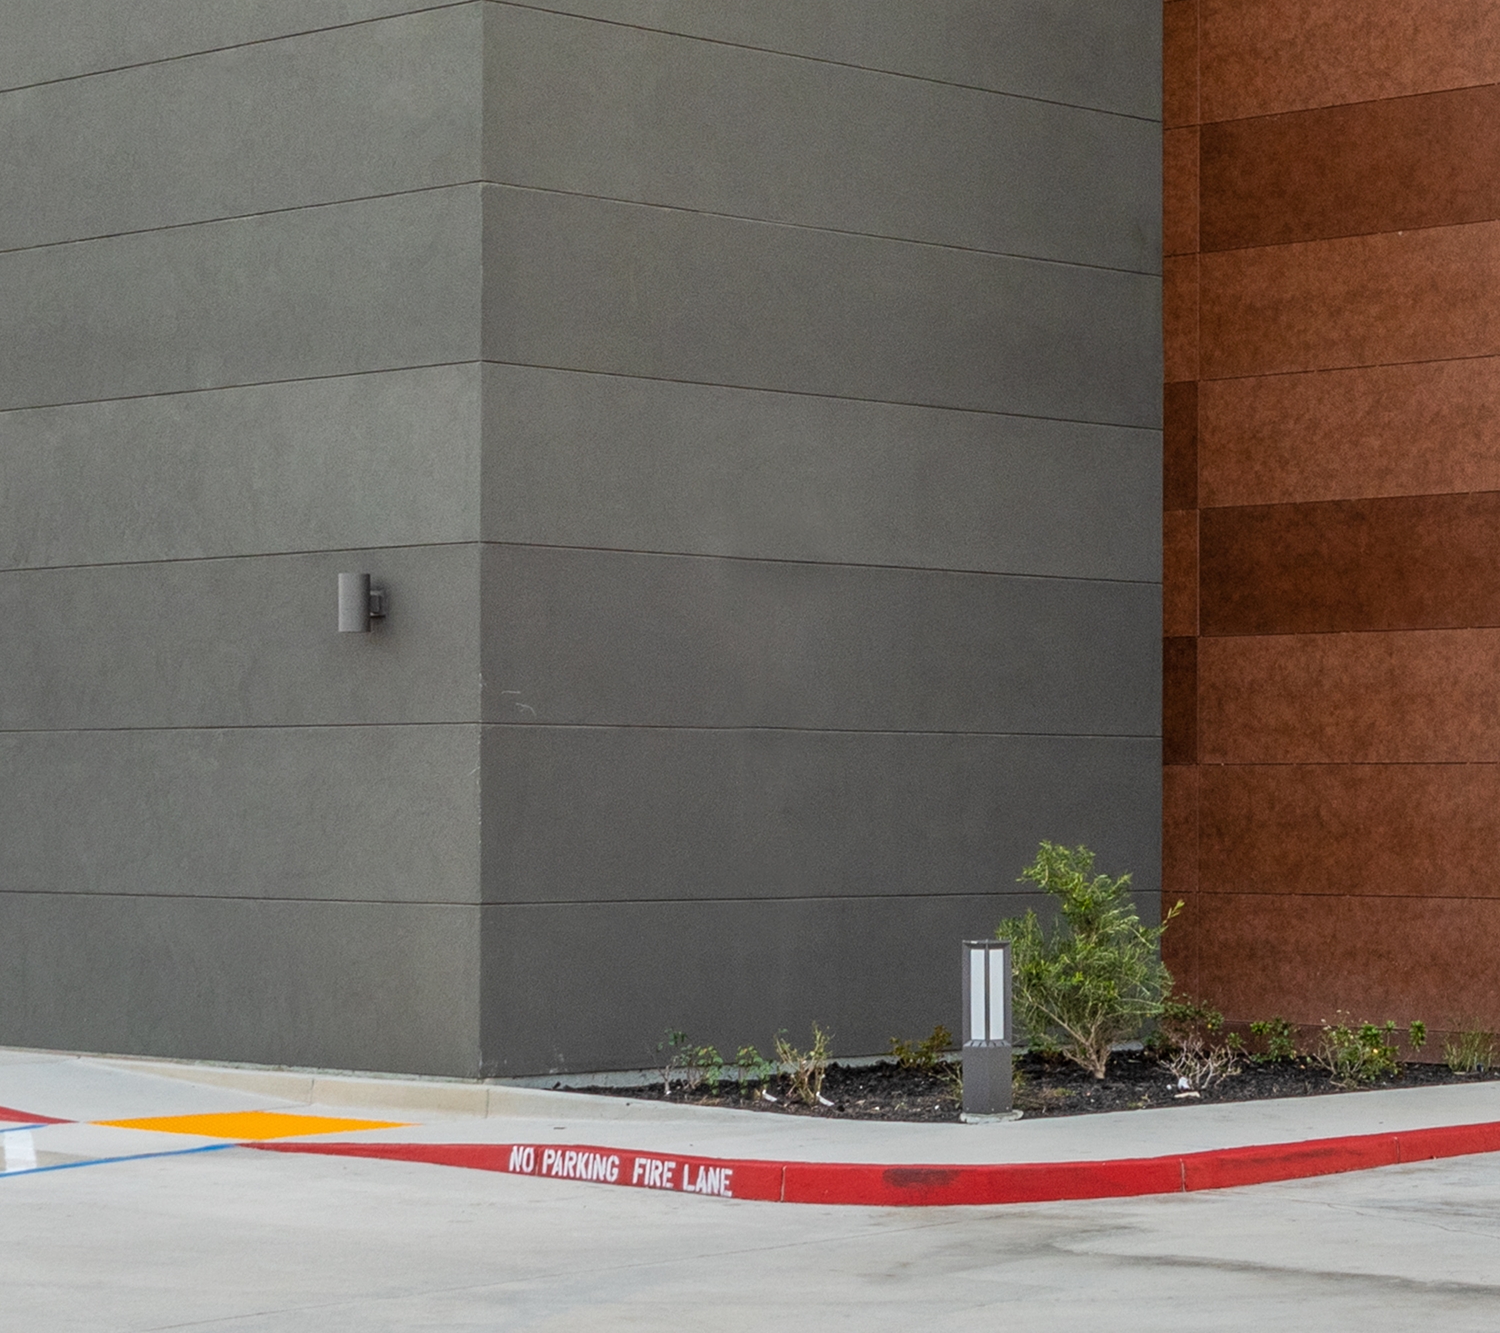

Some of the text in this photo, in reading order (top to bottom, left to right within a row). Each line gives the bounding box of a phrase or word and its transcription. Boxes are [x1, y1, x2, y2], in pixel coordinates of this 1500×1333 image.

[508, 1145, 733, 1197] NO PARKING FIRE LANE
